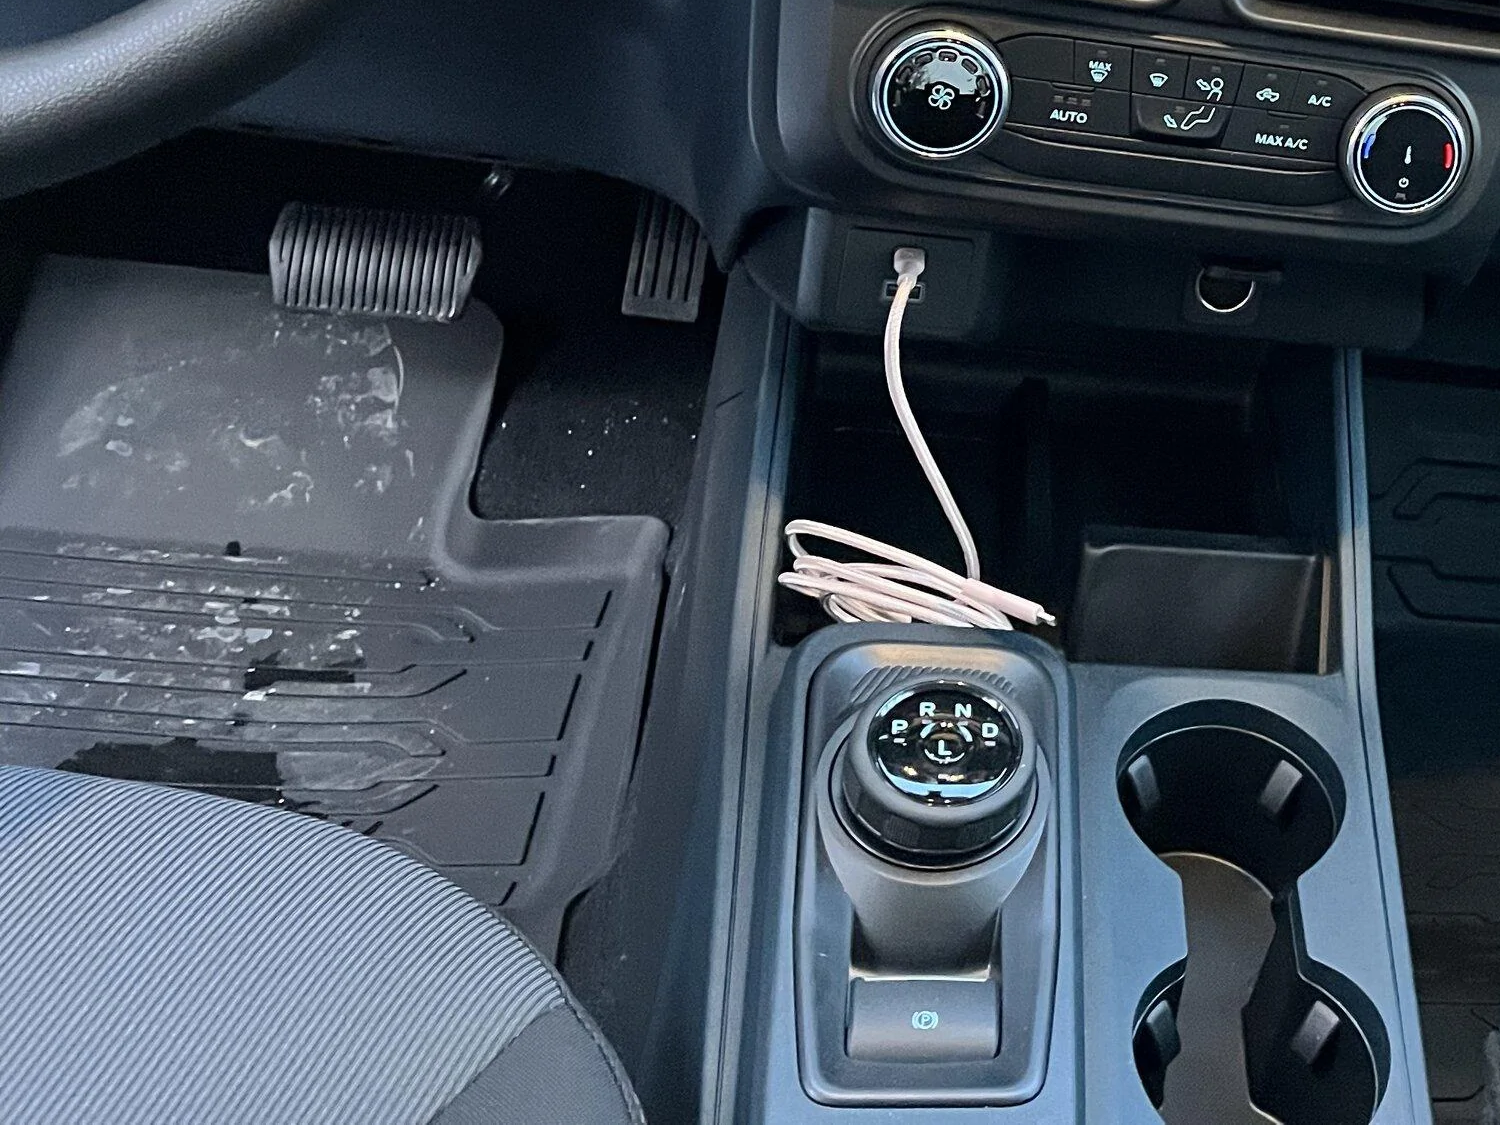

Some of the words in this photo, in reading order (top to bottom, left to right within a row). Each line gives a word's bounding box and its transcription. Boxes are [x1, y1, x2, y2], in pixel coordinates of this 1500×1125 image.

[1088, 59, 1112, 72] MAX
[1307, 94, 1332, 108] A/C
[1050, 108, 1088, 124] AUTO
[1255, 133, 1284, 147] MAX
[1284, 137, 1308, 151] A/C
[891, 719, 909, 735] P
[919, 701, 936, 717] R
[954, 703, 972, 718] N
[981, 722, 999, 738] D
[938, 739, 952, 756] L
